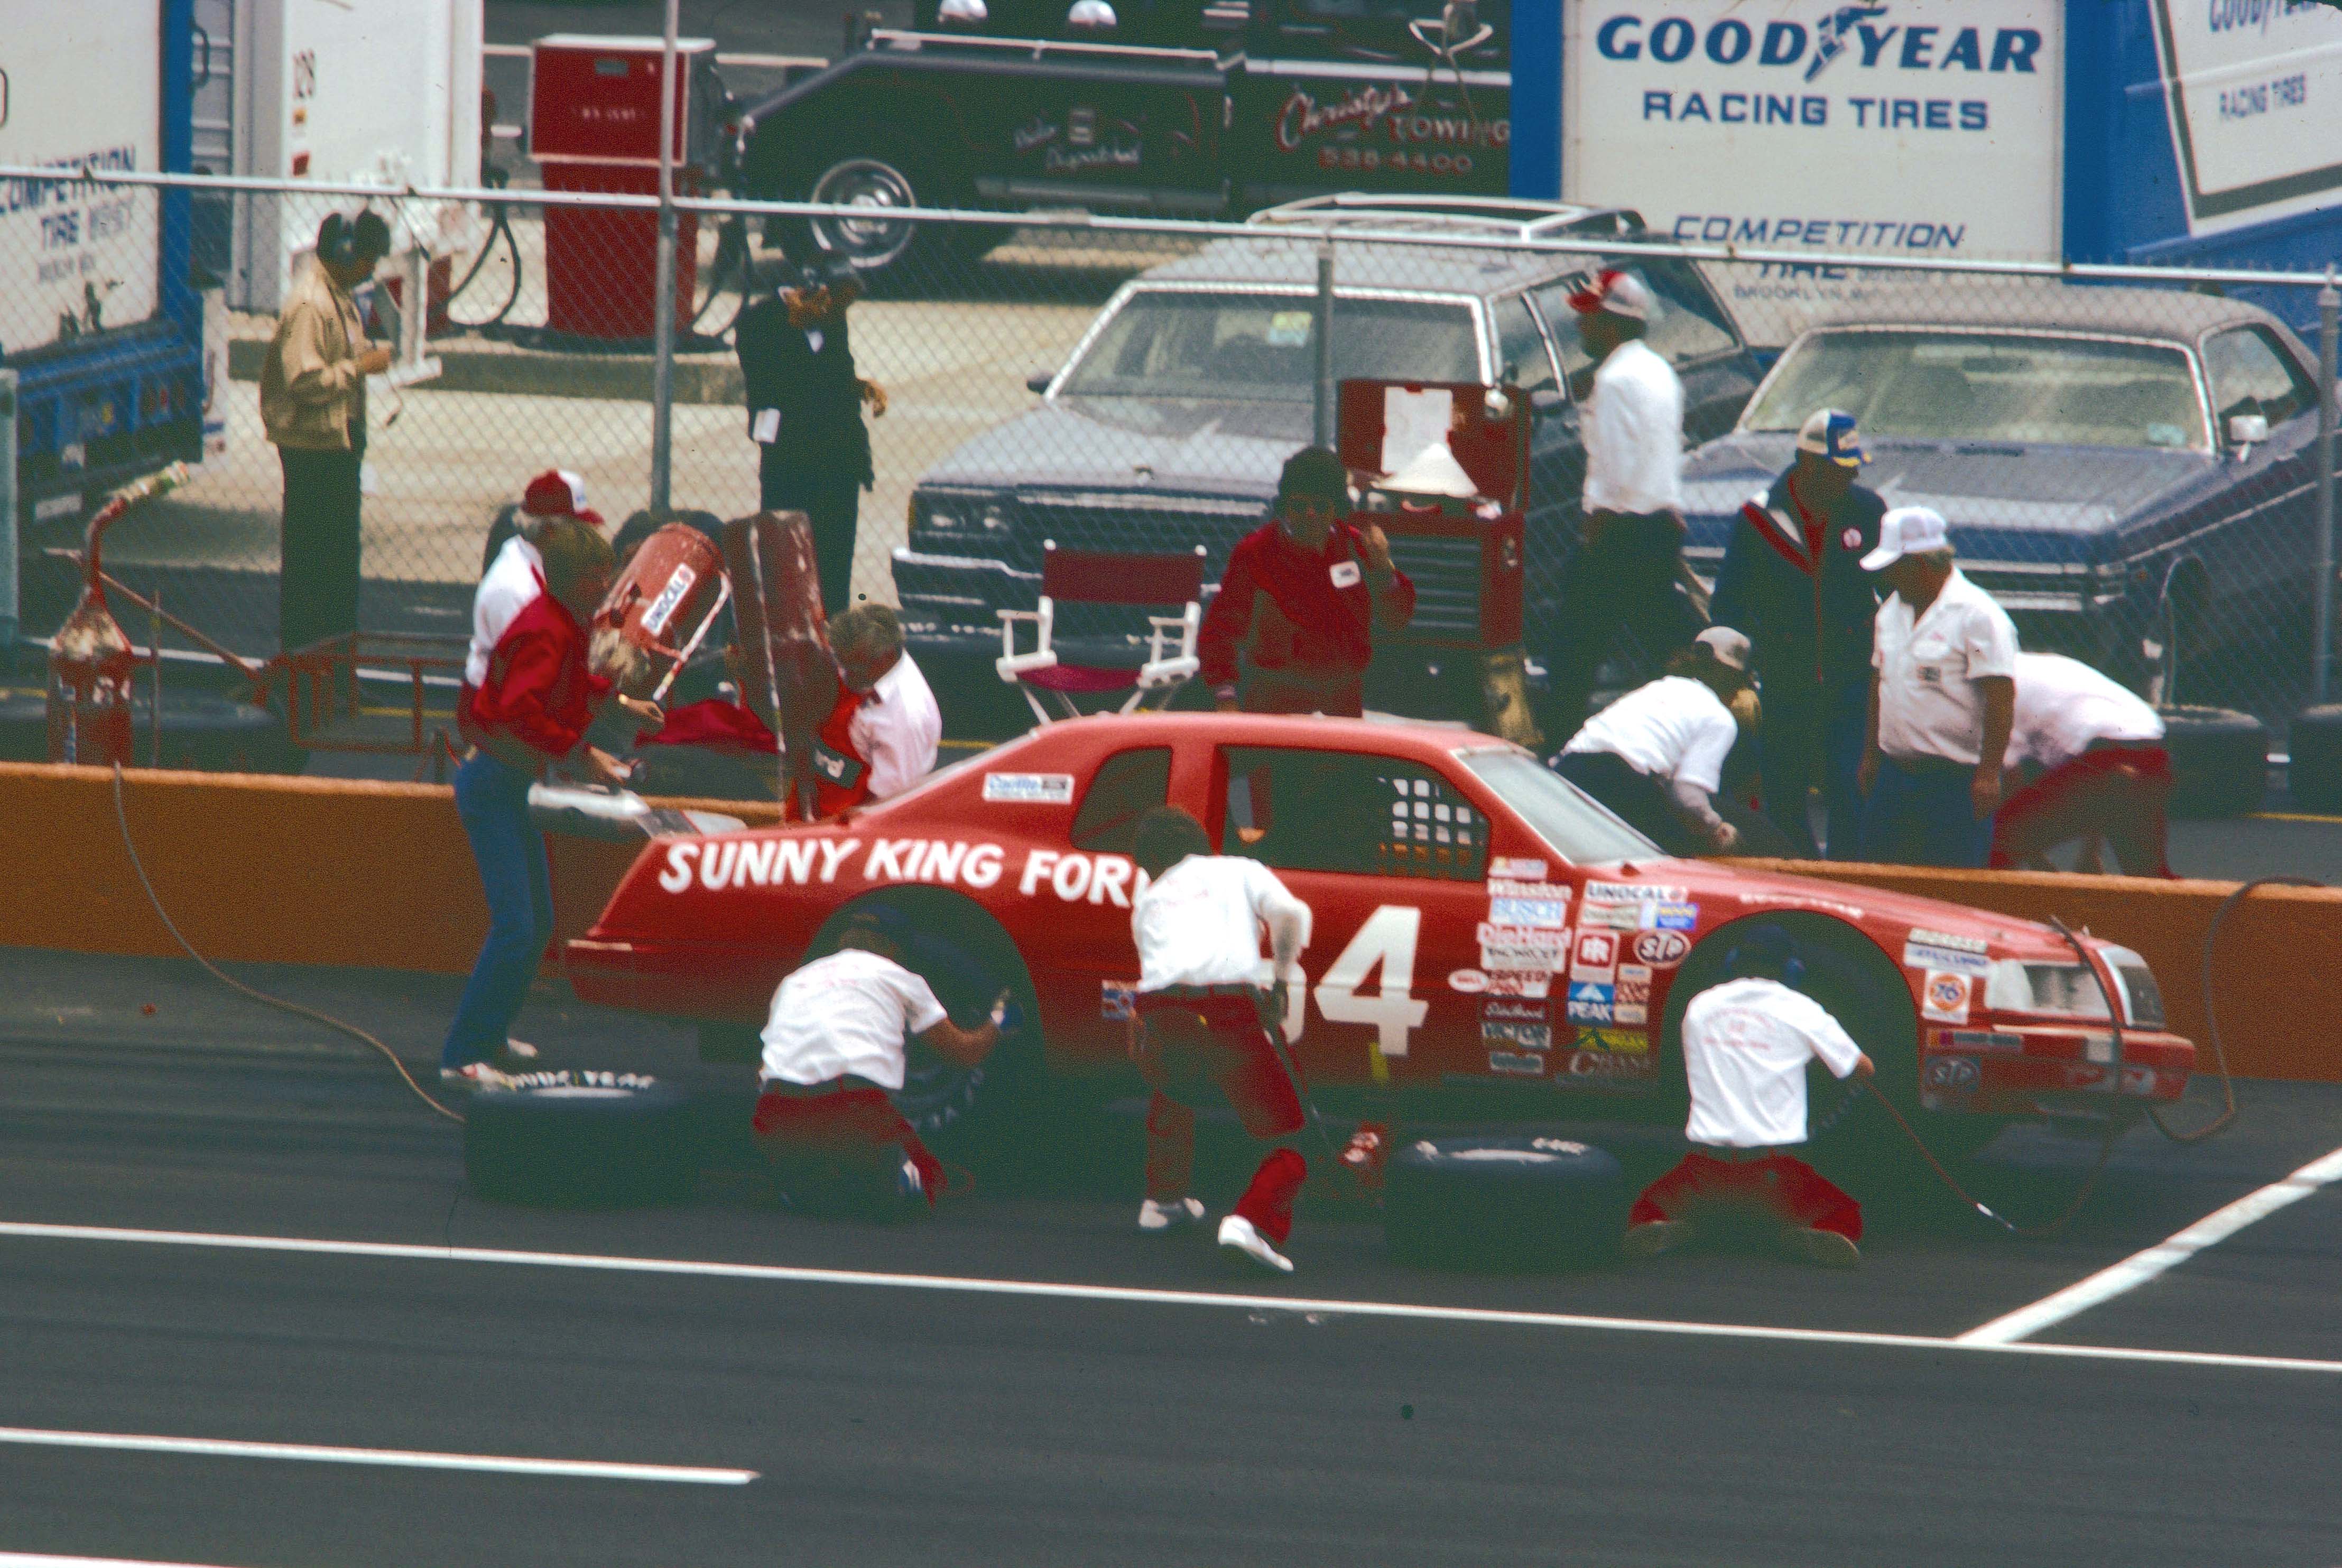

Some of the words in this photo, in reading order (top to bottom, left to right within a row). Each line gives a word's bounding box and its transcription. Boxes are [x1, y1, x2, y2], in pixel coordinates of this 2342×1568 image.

[1596, 14, 2042, 74] GOODYEAR
[1642, 90, 1829, 126] RACING
[1848, 97, 1989, 131] TIRES
[2219, 83, 2269, 120] RACING
[1671, 209, 1966, 249] COMPETITION
[659, 838, 863, 893] SUNNY
[863, 838, 1003, 889] KING
[1019, 848, 1151, 909] FOR
[1588, 882, 1665, 900] UNOCAL
[1640, 934, 1686, 961] STP
[1936, 984, 1960, 1000] 76
[1568, 1001, 1612, 1022] PEAK
